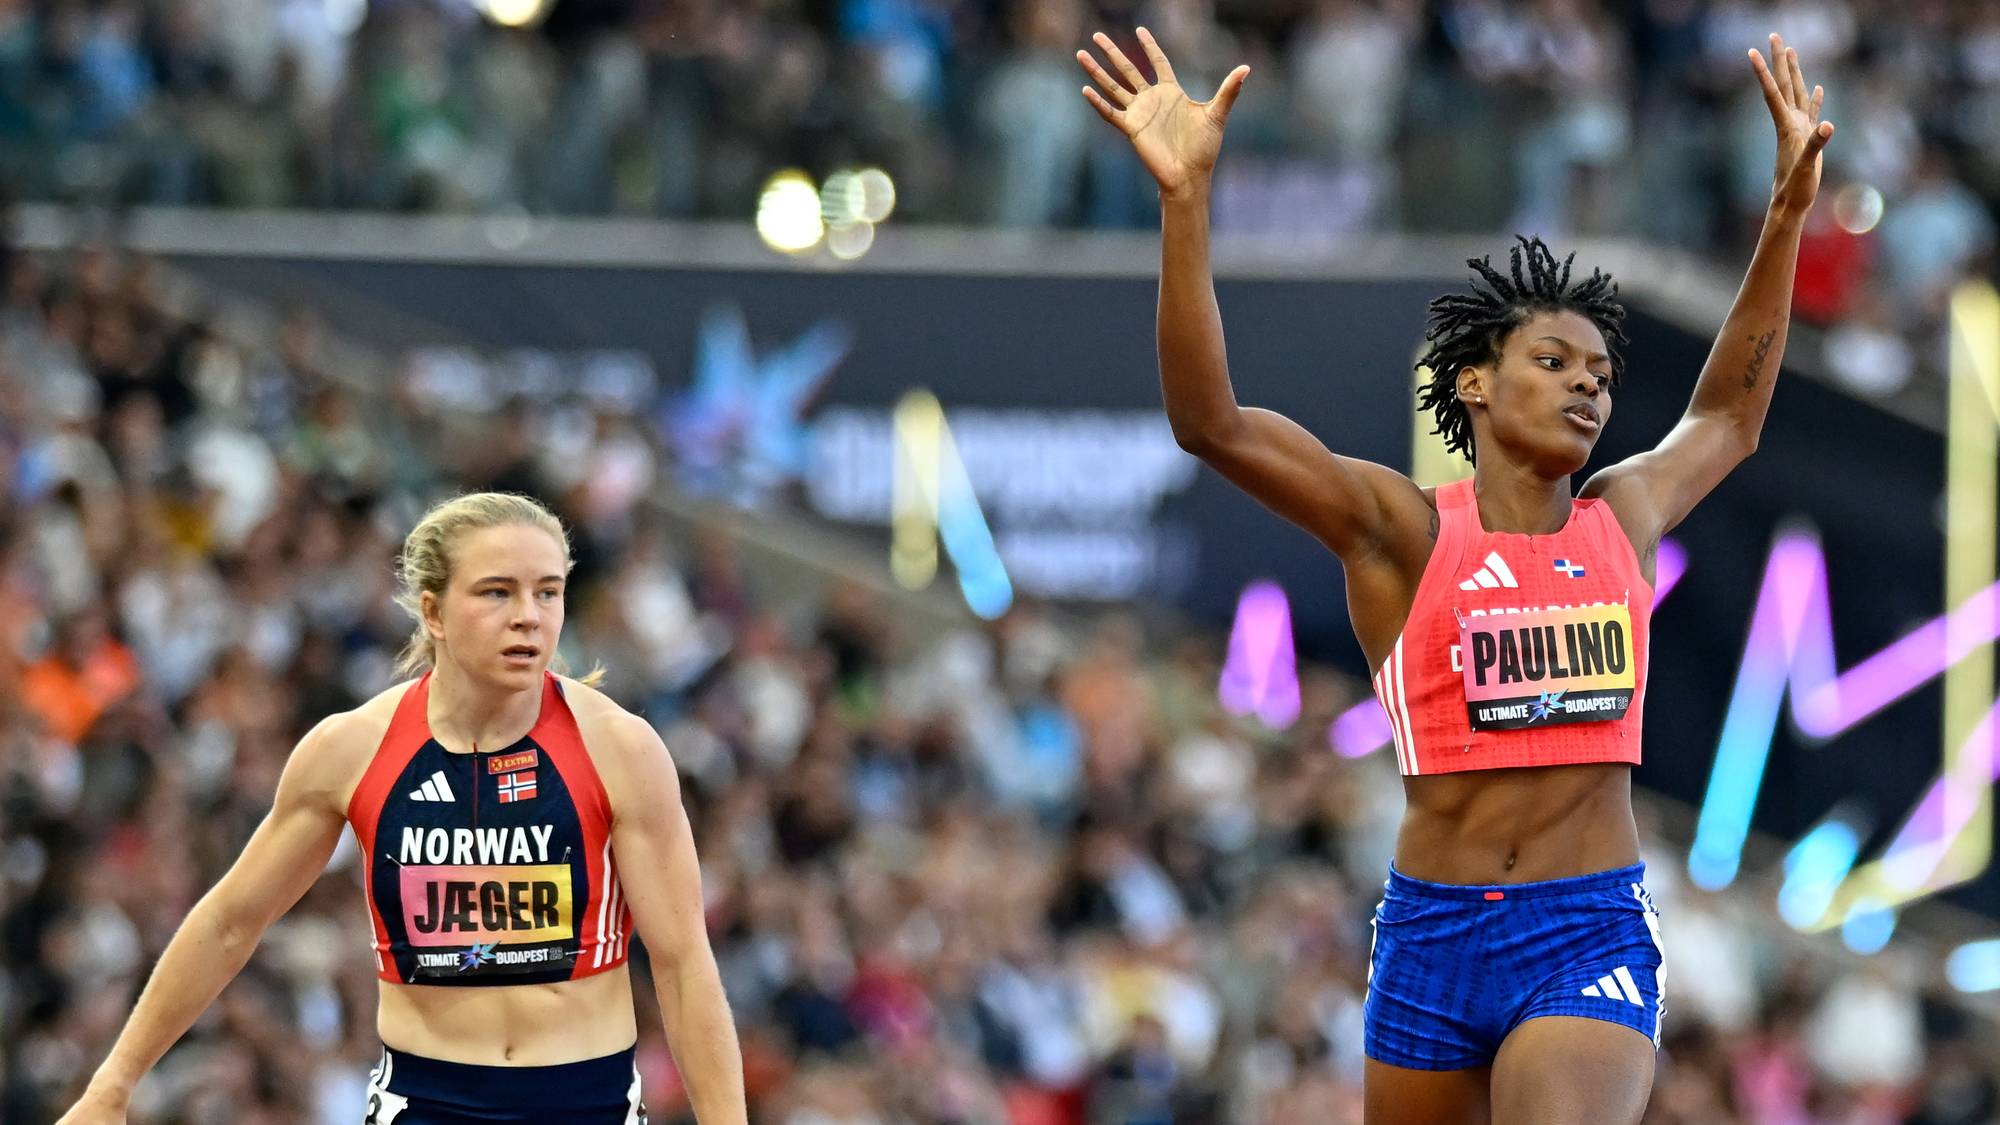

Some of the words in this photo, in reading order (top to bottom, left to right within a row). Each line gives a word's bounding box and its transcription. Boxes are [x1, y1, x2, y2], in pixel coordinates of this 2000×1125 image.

[1471, 620, 1626, 687] PAULINO
[1478, 704, 1529, 722] ULTIMATE
[1565, 696, 1617, 714] BUDAPEST
[504, 754, 535, 768] EXTRA
[400, 824, 554, 865] NORWAY
[413, 880, 560, 934] JÆGER
[496, 948, 549, 965] BUDAPEST
